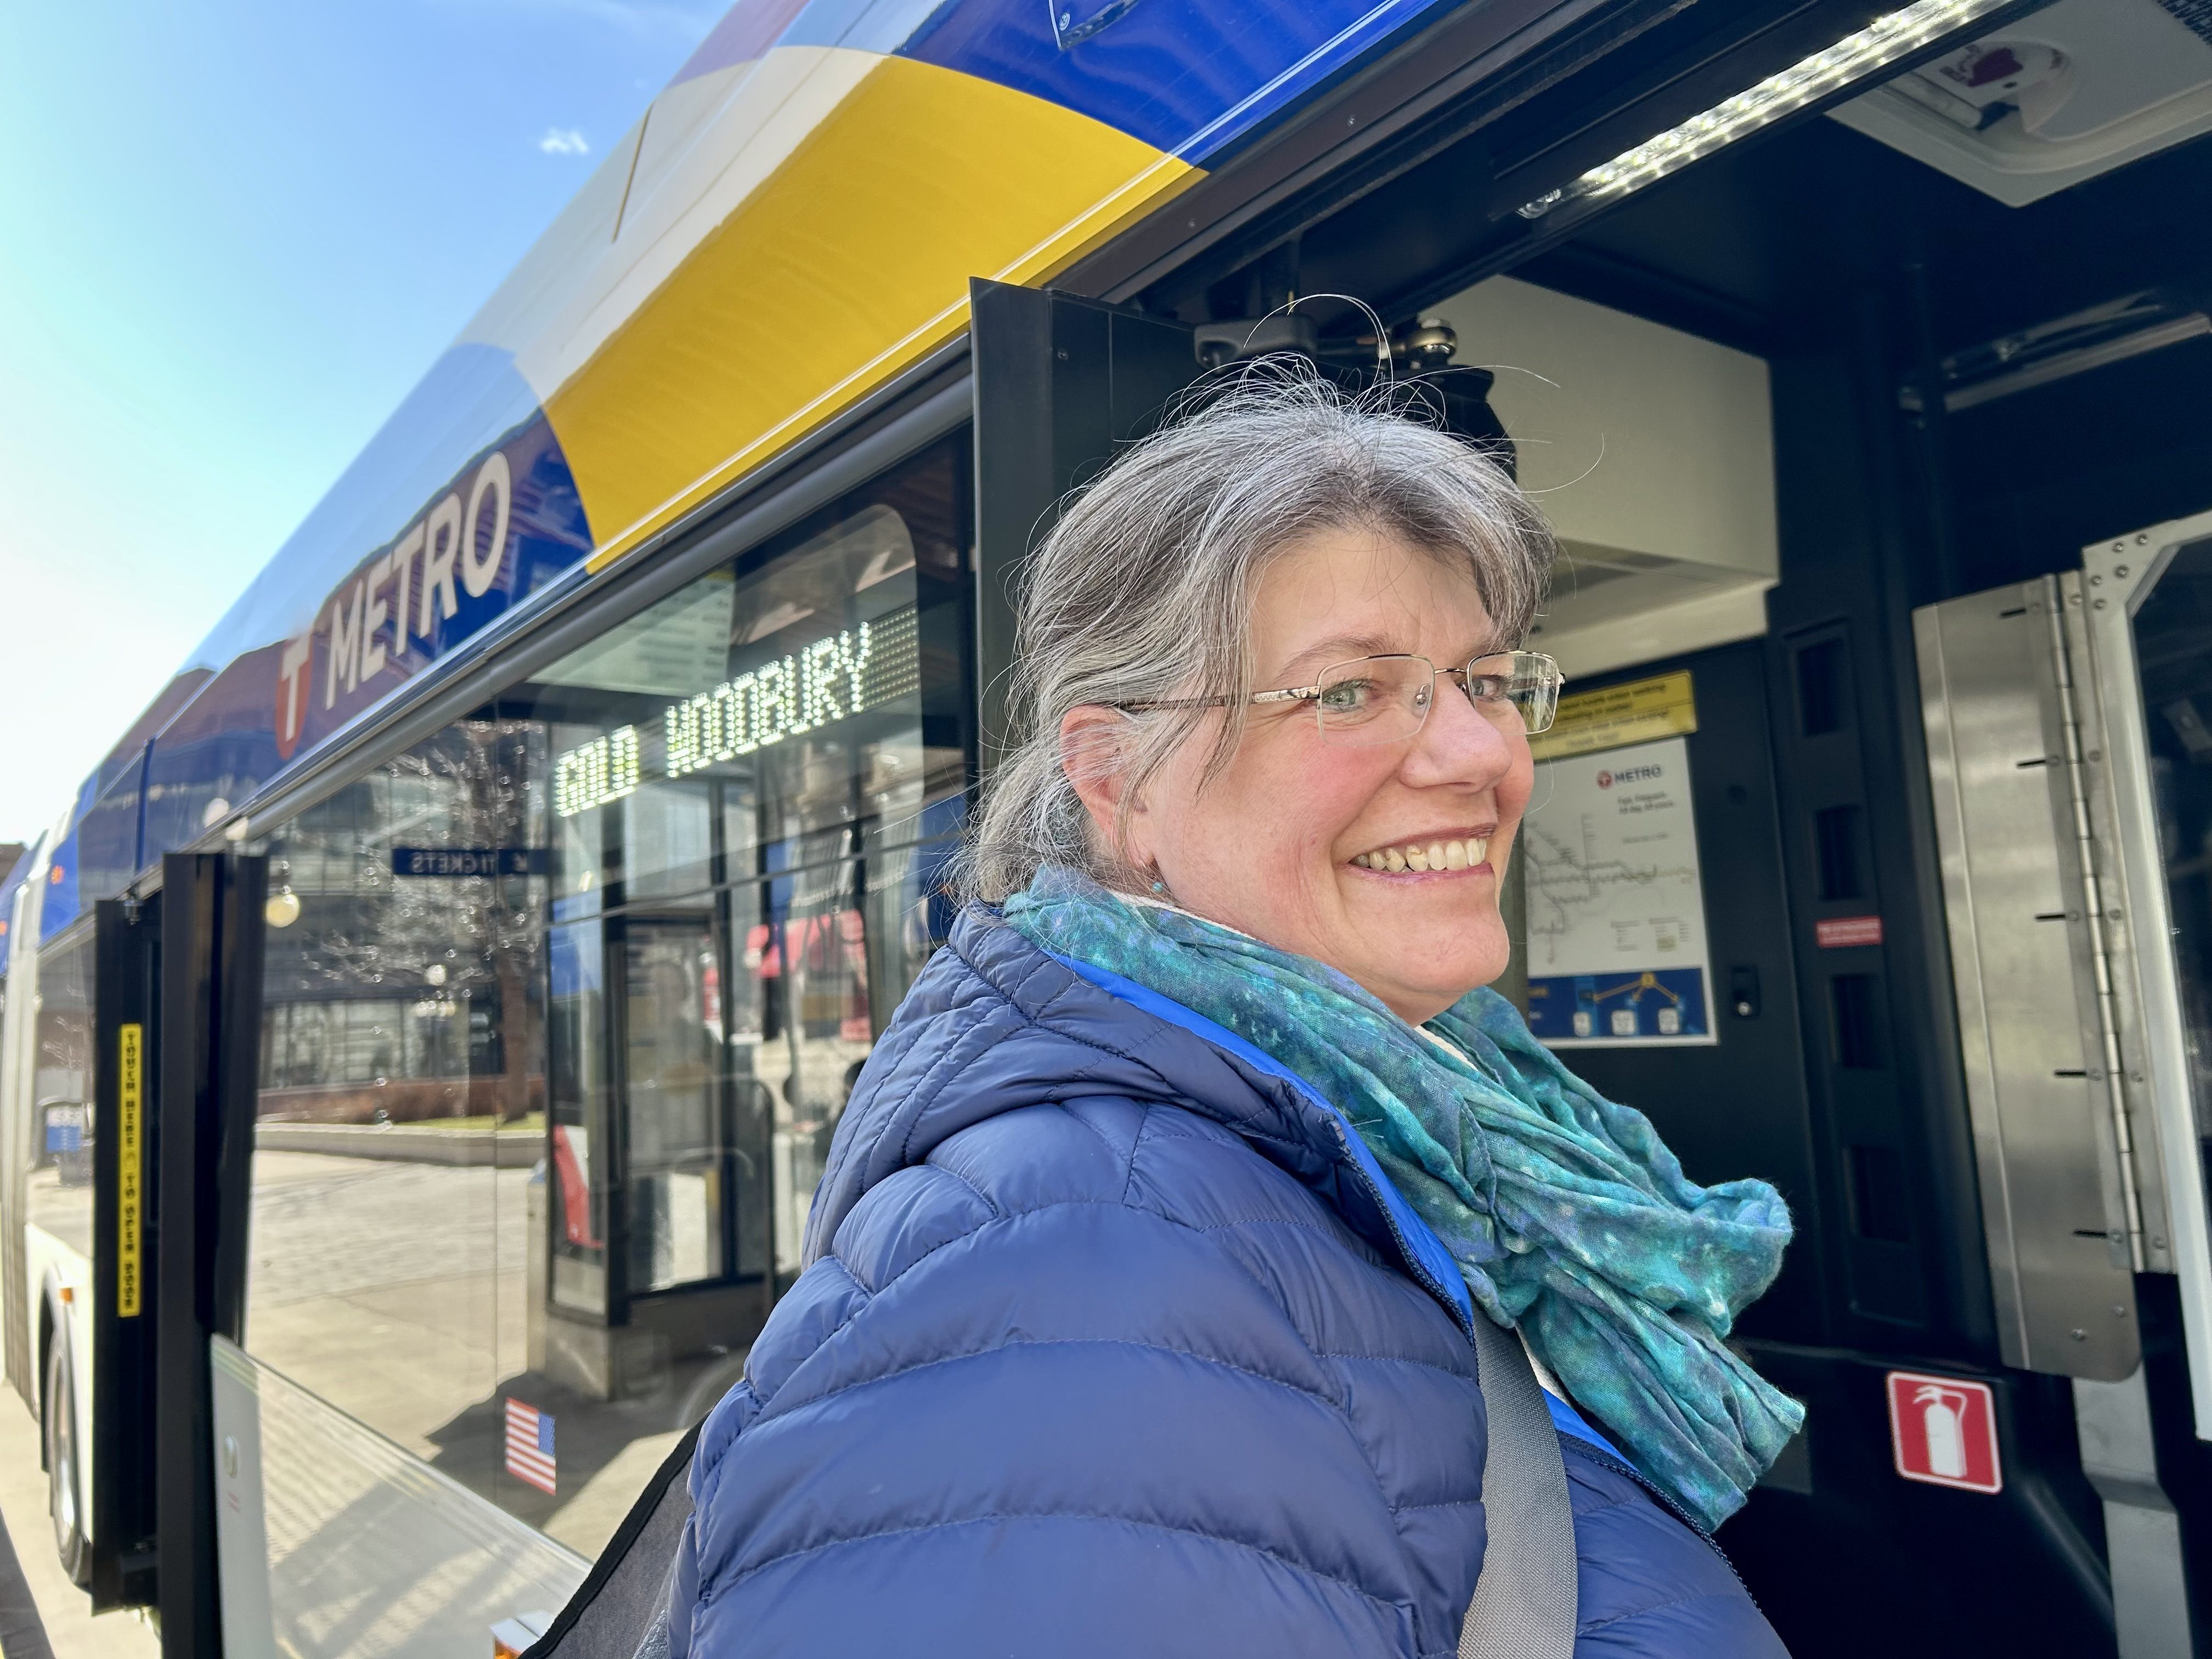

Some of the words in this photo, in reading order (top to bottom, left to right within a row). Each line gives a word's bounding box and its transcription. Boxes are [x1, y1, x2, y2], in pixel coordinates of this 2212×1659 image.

[325, 450, 511, 710] METRO
[665, 621, 872, 778] WOODBURY
[1614, 763, 1662, 783] METRO
